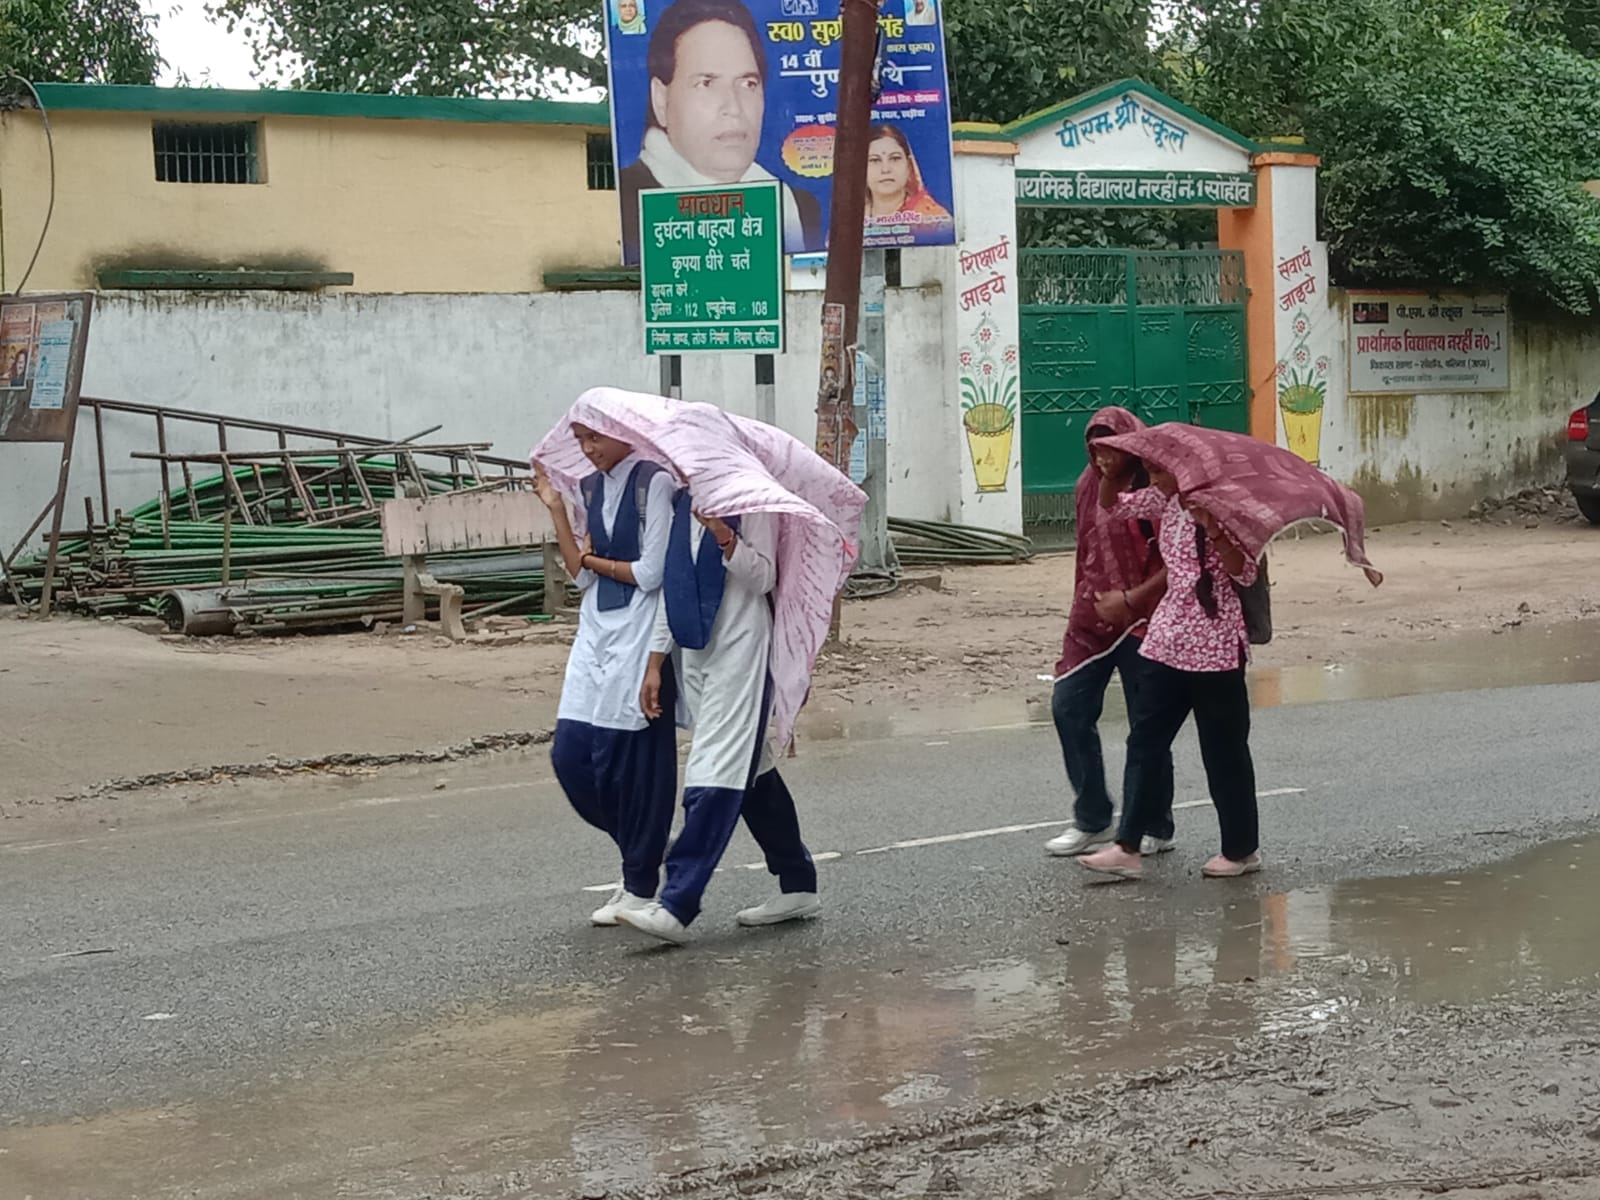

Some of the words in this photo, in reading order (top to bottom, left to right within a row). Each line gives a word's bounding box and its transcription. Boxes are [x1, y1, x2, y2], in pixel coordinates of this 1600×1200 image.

[780, 55, 799, 69] 14
[1116, 94, 1139, 131] श्री
[1141, 108, 1189, 153] स्कूल
[1016, 171, 1074, 200] ाथमिक
[1075, 172, 1137, 200] विद्यालय
[1138, 172, 1178, 202] नरही
[676, 192, 744, 218] सावधान
[653, 216, 695, 248] दुर्घटना
[742, 212, 763, 237] क्षेत्र
[671, 255, 701, 279] कृपया
[705, 248, 724, 272] धीरे
[730, 246, 751, 270] चलें
[650, 298, 673, 321] पुलिस
[685, 303, 698, 317] 112
[752, 301, 768, 316] 108
[1357, 328, 1402, 353] प्राथमिक
[1403, 328, 1446, 352] विद्यालय
